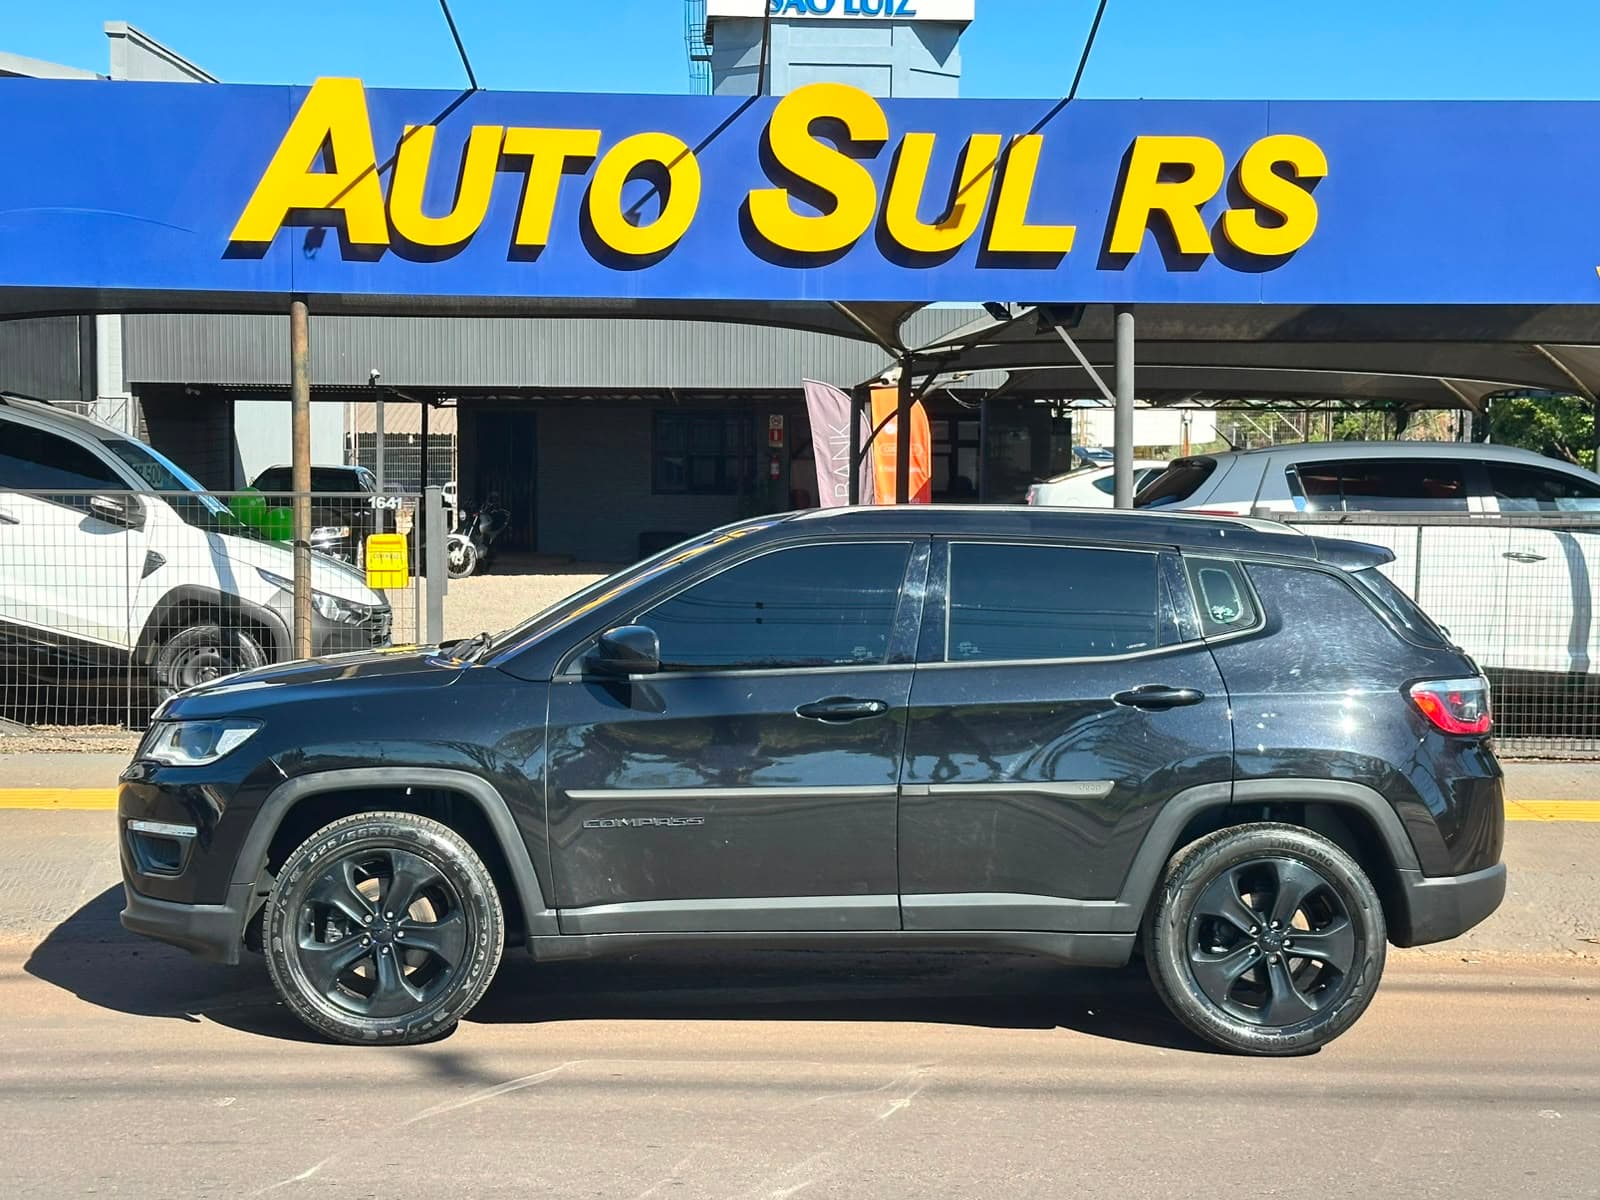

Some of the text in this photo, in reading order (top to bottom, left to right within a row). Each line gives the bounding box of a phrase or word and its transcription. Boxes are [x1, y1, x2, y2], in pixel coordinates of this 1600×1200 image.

[229, 76, 1329, 256] AUTO SUL RS
[828, 424, 849, 497] BANK
[368, 496, 402, 509] 1641
[583, 817, 704, 828] COMPASS
[1269, 838, 1334, 868] LINGLONG
